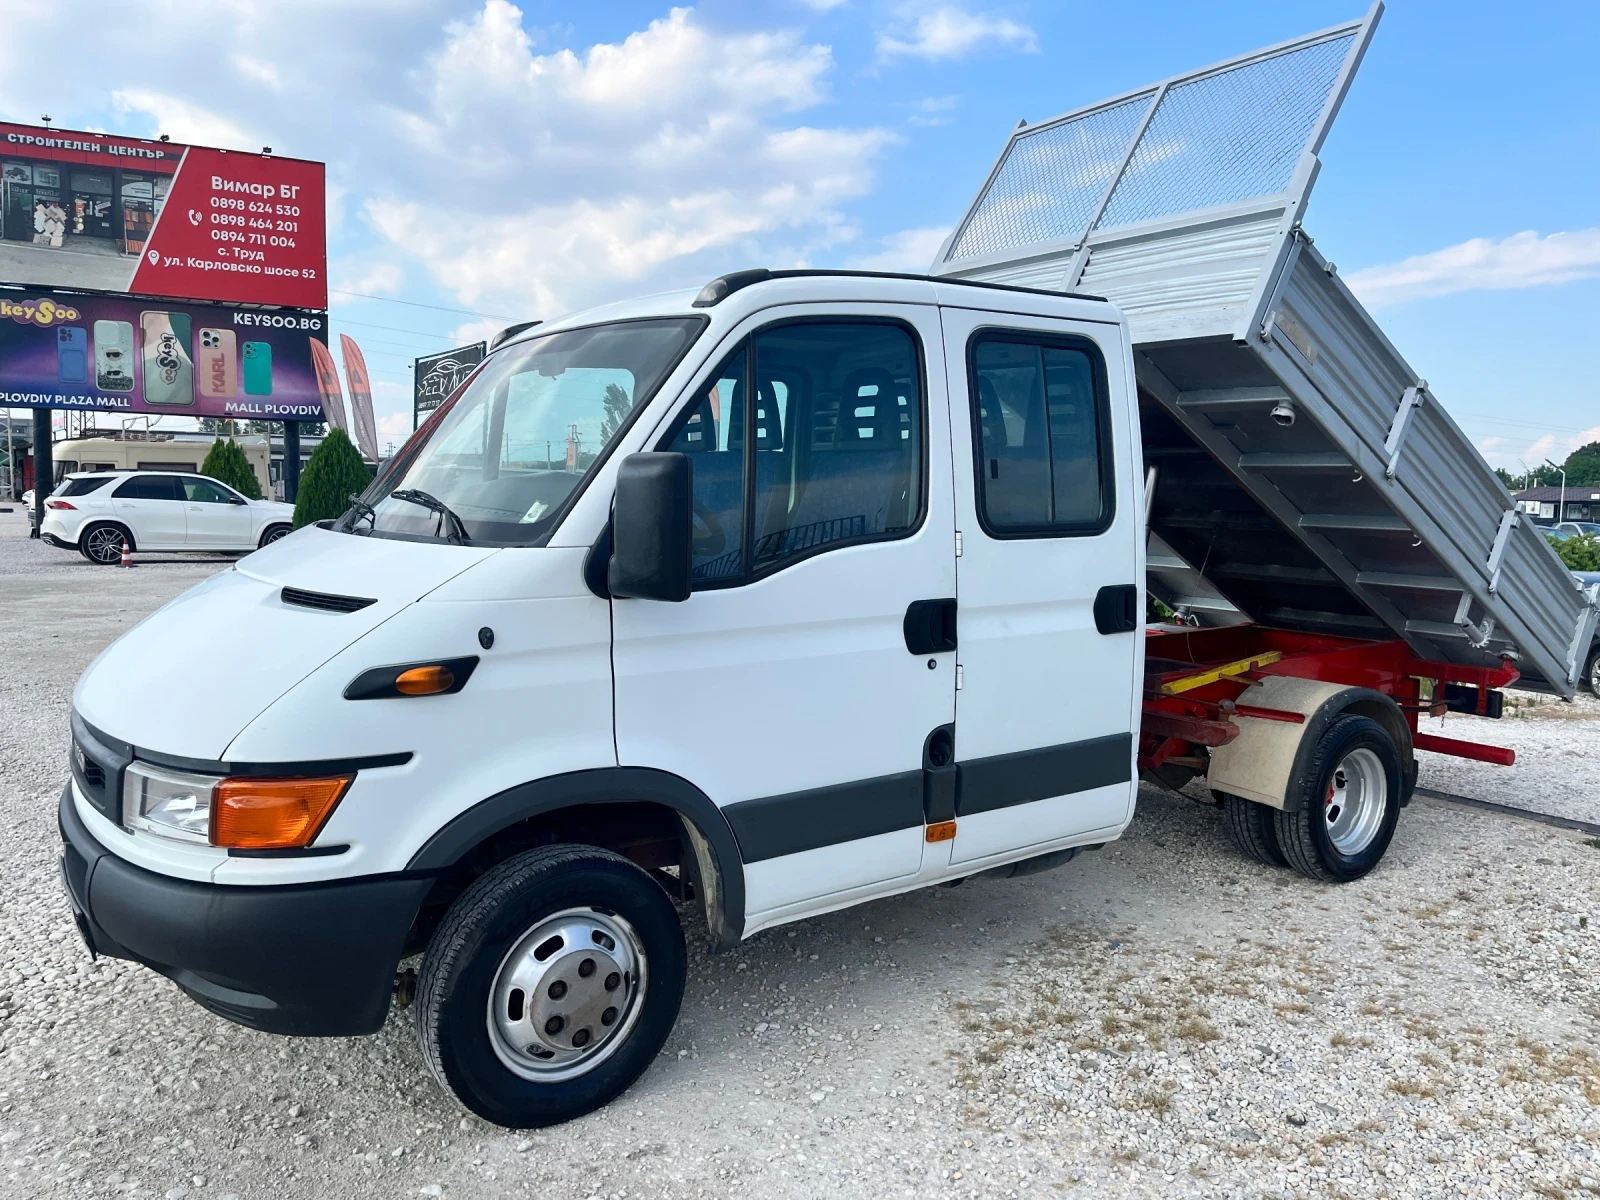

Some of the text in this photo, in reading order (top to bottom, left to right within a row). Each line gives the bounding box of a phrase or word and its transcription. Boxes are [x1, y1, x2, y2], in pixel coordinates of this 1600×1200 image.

[7, 133, 165, 159] СТРОИТЕЛЕН ЦЕНТЪР
[211, 175, 300, 199] Вимар БГ
[210, 197, 300, 217] 0898 624 530
[211, 213, 298, 232] 0898 464 201
[211, 230, 295, 248] 0894 711 004
[218, 247, 264, 261] с. Труд
[164, 257, 316, 279] ул. Карловско шосе 52
[1, 301, 77, 324] keySoo
[233, 312, 321, 330] KEYSOO.BG
[159, 335, 178, 381] keySoo
[211, 353, 225, 393] KARL
[0, 392, 130, 407] PLOVDIV PLAZA MALL
[225, 402, 321, 416] MALL PLOVDIV
